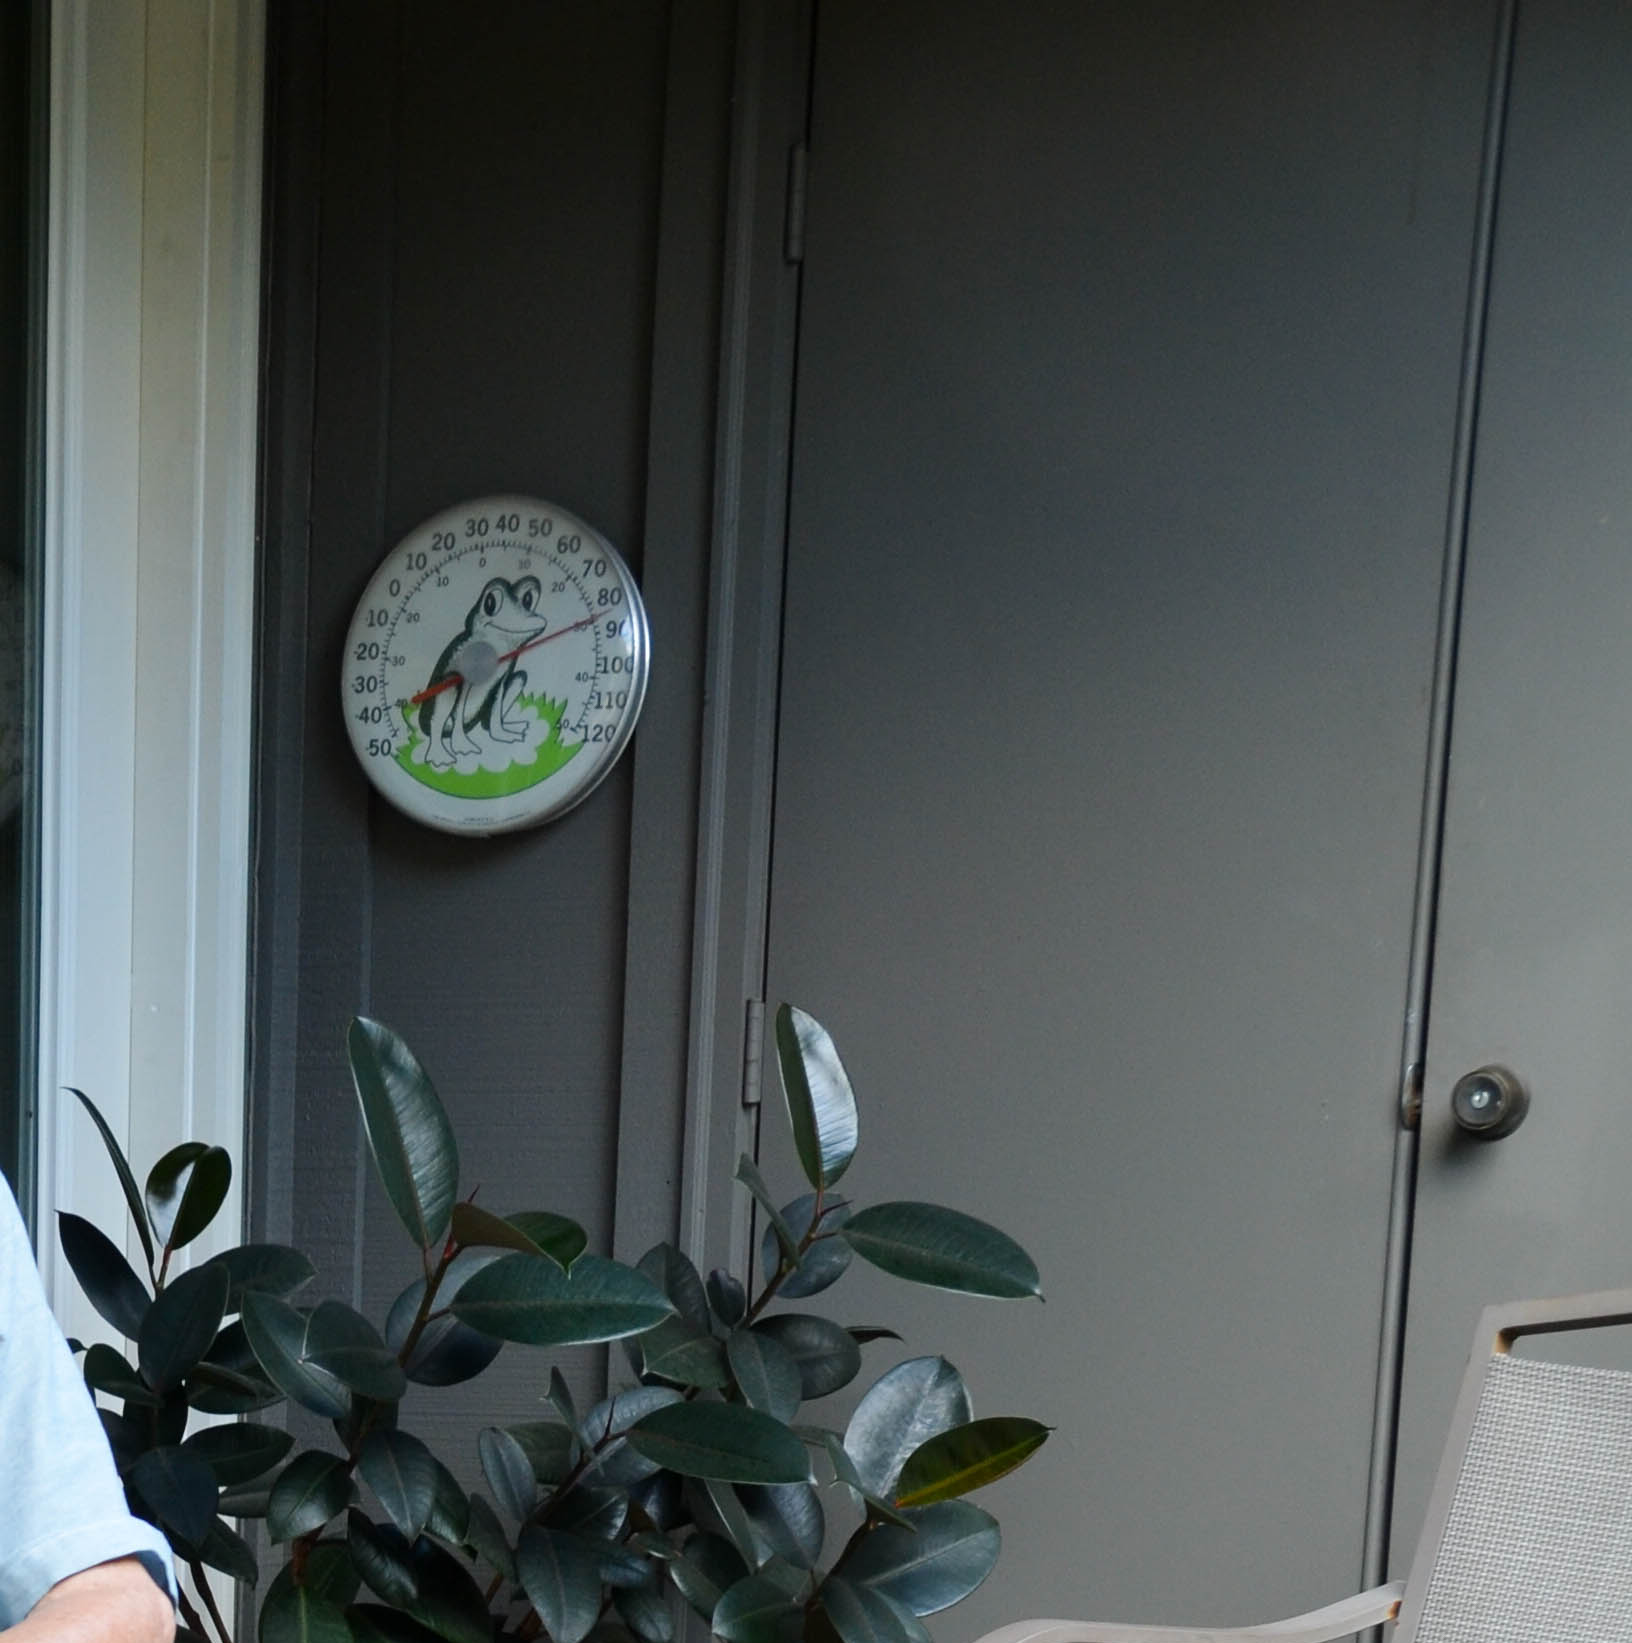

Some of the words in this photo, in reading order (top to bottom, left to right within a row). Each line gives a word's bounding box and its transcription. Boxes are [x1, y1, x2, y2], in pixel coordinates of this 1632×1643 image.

[465, 519, 488, 537] 30
[496, 514, 520, 533] 40
[528, 519, 552, 538] 50
[432, 533, 456, 551] 20
[557, 535, 581, 554] 60
[406, 552, 427, 570] 10
[582, 559, 606, 578] 70
[597, 587, 622, 606] 80
[600, 656, 634, 674] 100
[593, 691, 627, 709] 110
[583, 724, 616, 743] 120
